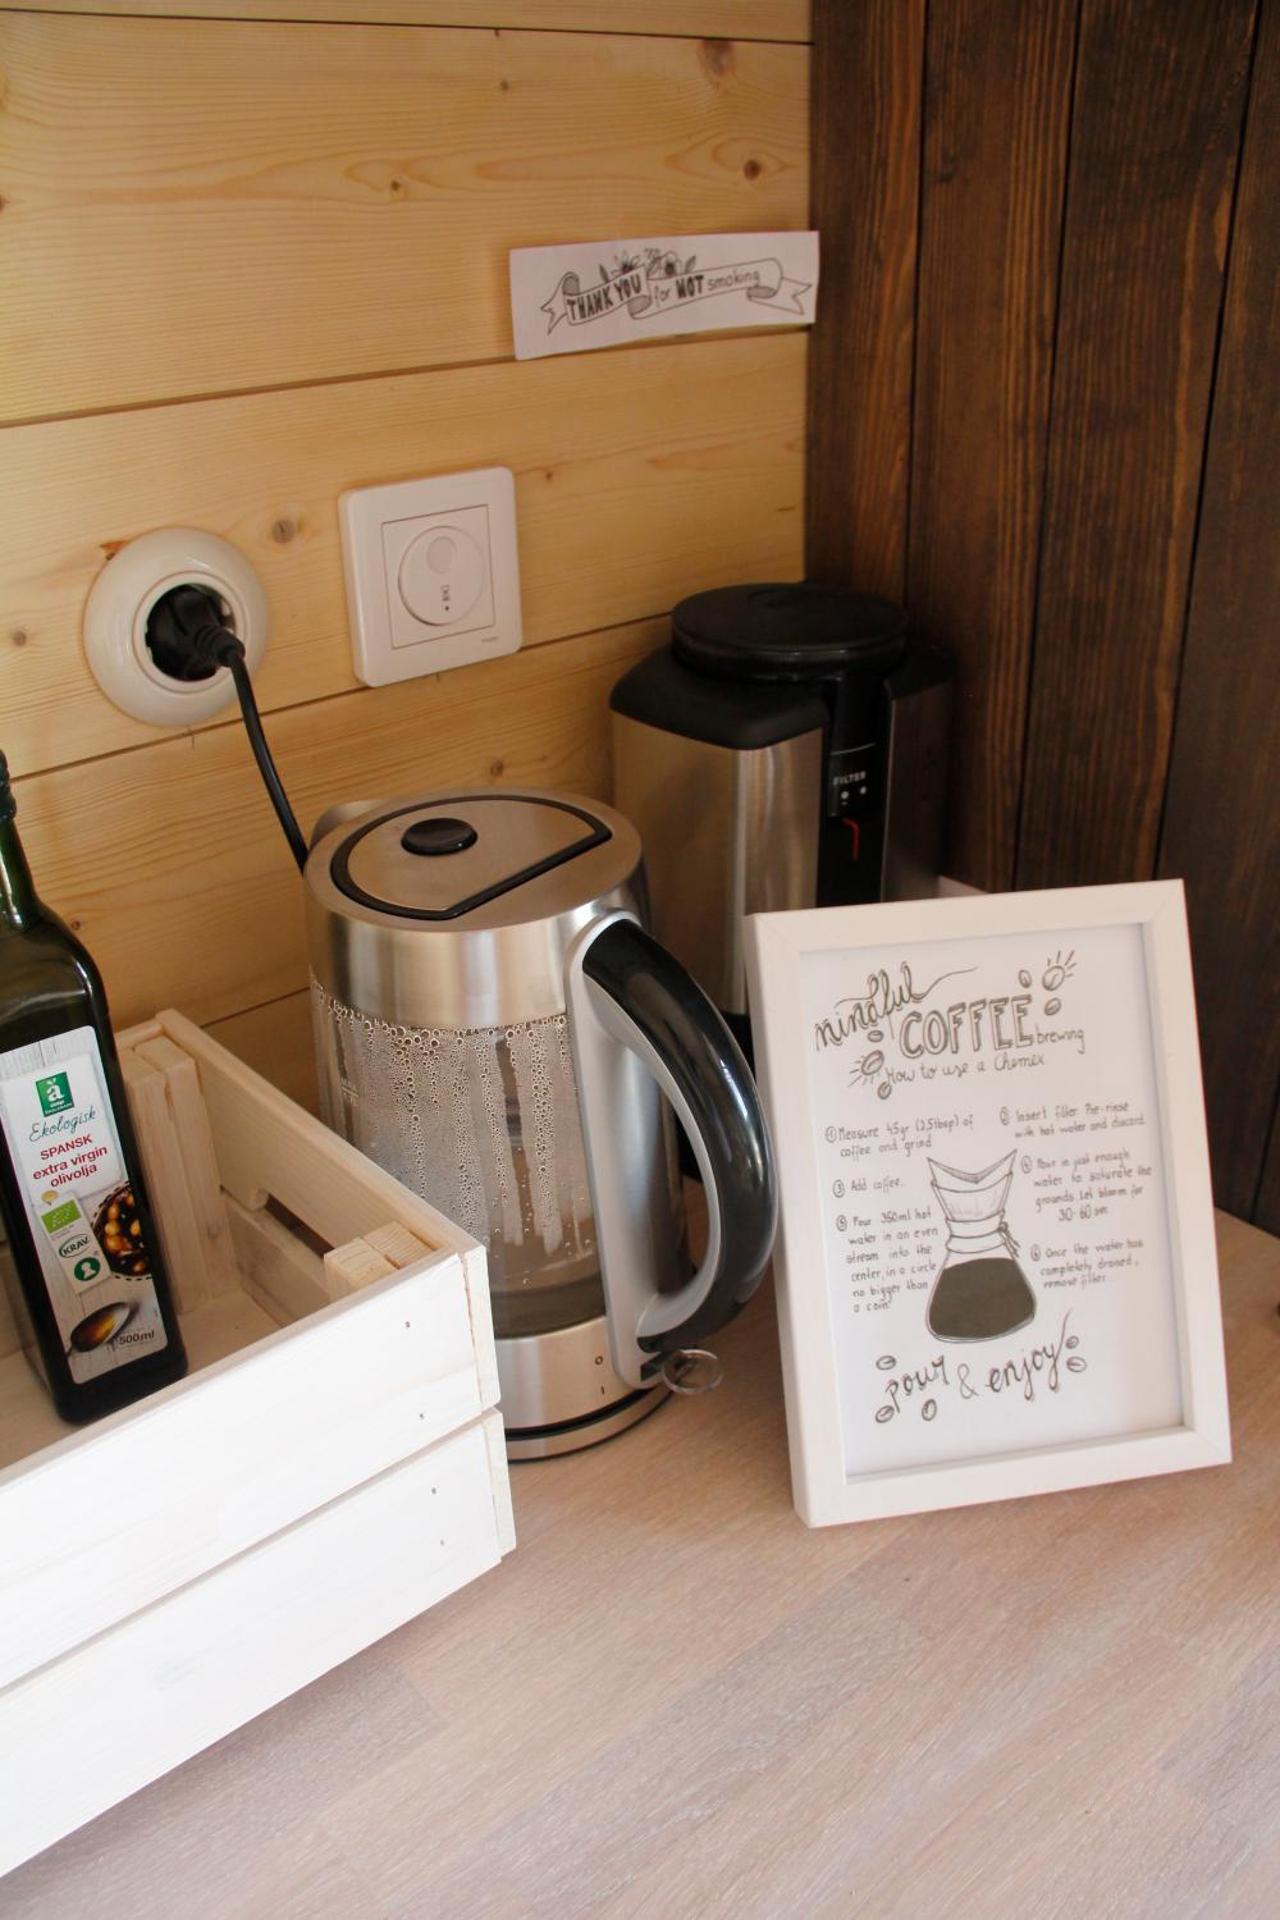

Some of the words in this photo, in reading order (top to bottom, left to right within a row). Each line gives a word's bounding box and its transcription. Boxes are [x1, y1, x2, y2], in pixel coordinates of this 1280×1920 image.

[566, 289, 613, 321] THANK
[615, 274, 642, 302] YOU
[653, 285, 671, 308] for
[676, 274, 704, 297] NOT
[707, 269, 760, 292] smoking
[815, 960, 968, 1051] mindful
[900, 994, 1034, 1059] COFFEE
[1035, 1027, 1085, 1055] brewing
[884, 1065, 916, 1086] How
[920, 1063, 937, 1080] to
[943, 1061, 970, 1079] use
[976, 1060, 987, 1073] a
[29, 1104, 97, 1143] Ekologisk
[838, 1126, 879, 1141] Measure
[963, 1114, 974, 1130] of
[1040, 1122, 1055, 1136] hot
[1060, 1120, 1086, 1133] water
[1090, 1116, 1107, 1131] and
[40, 1134, 93, 1160] SPANSK
[840, 1144, 871, 1162] coffee
[878, 1138, 898, 1153] and
[904, 1134, 932, 1157] grind
[1095, 1147, 1131, 1169] enough
[33, 1161, 68, 1180] extra
[70, 1146, 108, 1166] virgin
[50, 1164, 98, 1188] olivolja
[851, 1177, 867, 1191] Add
[1033, 1175, 1063, 1187] water
[1070, 1172, 1083, 1183] to
[1089, 1167, 1133, 1182] saturate
[1137, 1165, 1153, 1176] the
[853, 1216, 871, 1227] Pour
[915, 1206, 931, 1219] hot
[63, 1236, 89, 1255] KRAV
[848, 1232, 876, 1245] water
[883, 1231, 892, 1241] in
[896, 1231, 910, 1240] an
[914, 1227, 938, 1238] even
[846, 1251, 879, 1264] stream
[888, 1245, 910, 1259] into
[916, 1244, 932, 1255] the
[1045, 1247, 1067, 1258] Once
[1073, 1243, 1089, 1255] the
[1095, 1239, 1124, 1251] water
[886, 1268, 896, 1277] in
[899, 1267, 906, 1275] a
[911, 1259, 937, 1274] circle
[1040, 1258, 1093, 1277] completely
[852, 1289, 865, 1298] no
[870, 1284, 901, 1303] bigger
[906, 1279, 928, 1290] than
[1043, 1277, 1077, 1289] remove
[854, 1303, 860, 1313] a
[886, 1354, 950, 1413] pour
[956, 1363, 979, 1399] &
[985, 1312, 1071, 1400] enjoy
